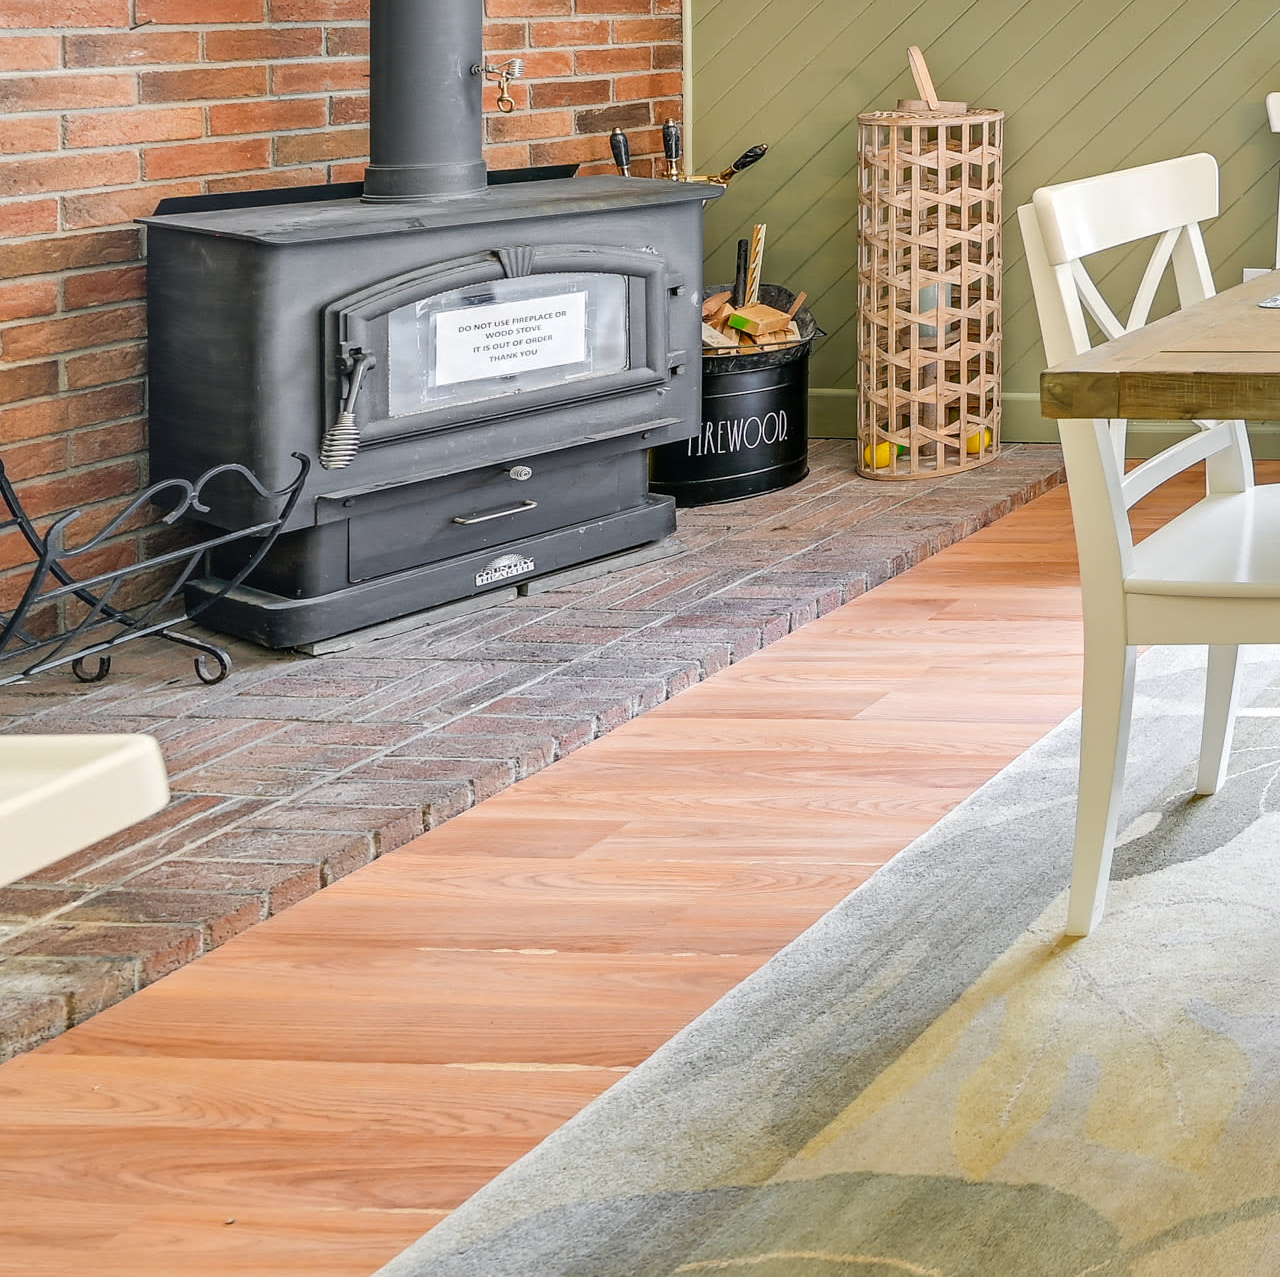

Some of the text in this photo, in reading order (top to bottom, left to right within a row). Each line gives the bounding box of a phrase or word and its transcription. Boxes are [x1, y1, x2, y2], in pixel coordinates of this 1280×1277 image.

[458, 310, 567, 333] DO NOT USE FIREPLACE OR
[485, 325, 542, 339] WOOD STOVE
[482, 344, 491, 352] IS
[492, 341, 510, 350] OUT
[512, 338, 524, 346] OF
[525, 334, 553, 345] ORDER
[490, 349, 538, 363] THANK YOU
[475, 557, 534, 579] COUNTRY
